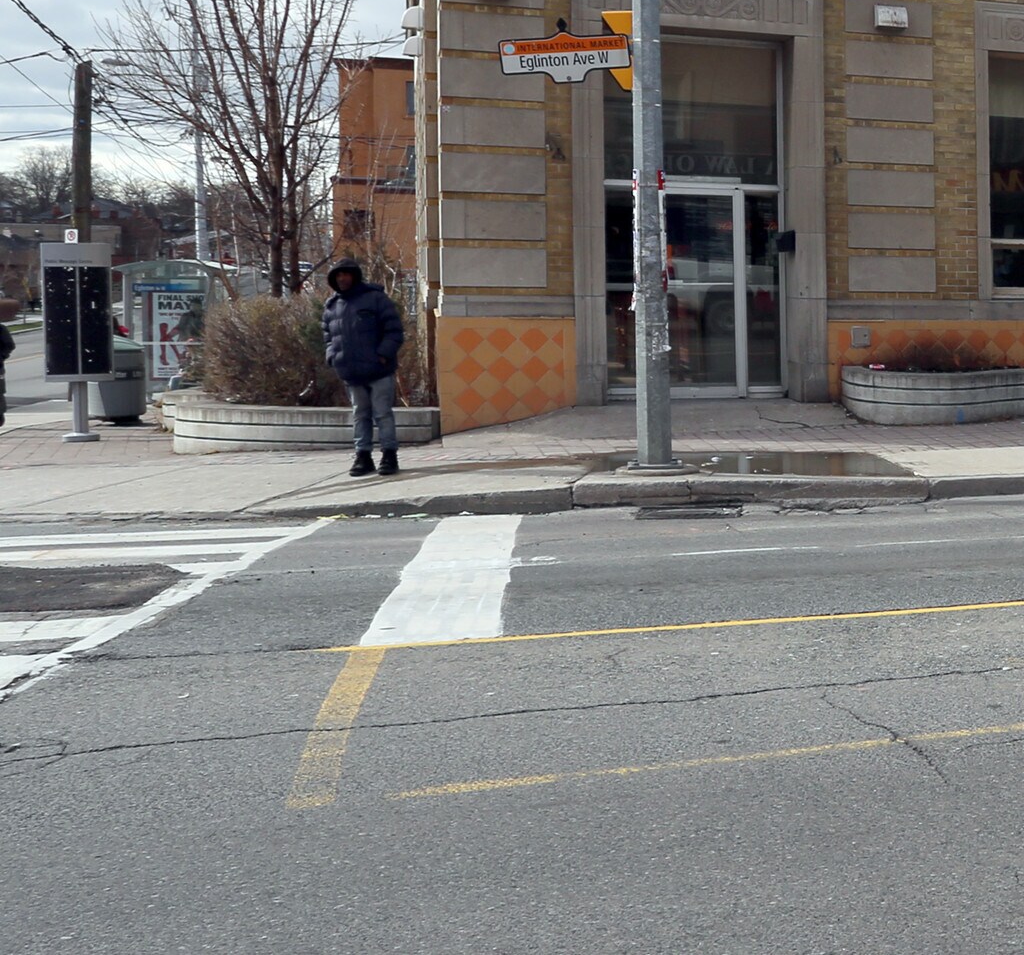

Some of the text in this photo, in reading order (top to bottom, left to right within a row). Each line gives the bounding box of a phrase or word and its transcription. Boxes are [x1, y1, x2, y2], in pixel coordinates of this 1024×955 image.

[517, 39, 624, 53] INTERNATIONAL MARKET
[520, 51, 609, 71] Eglinton Ave W
[158, 301, 191, 310] MAY
